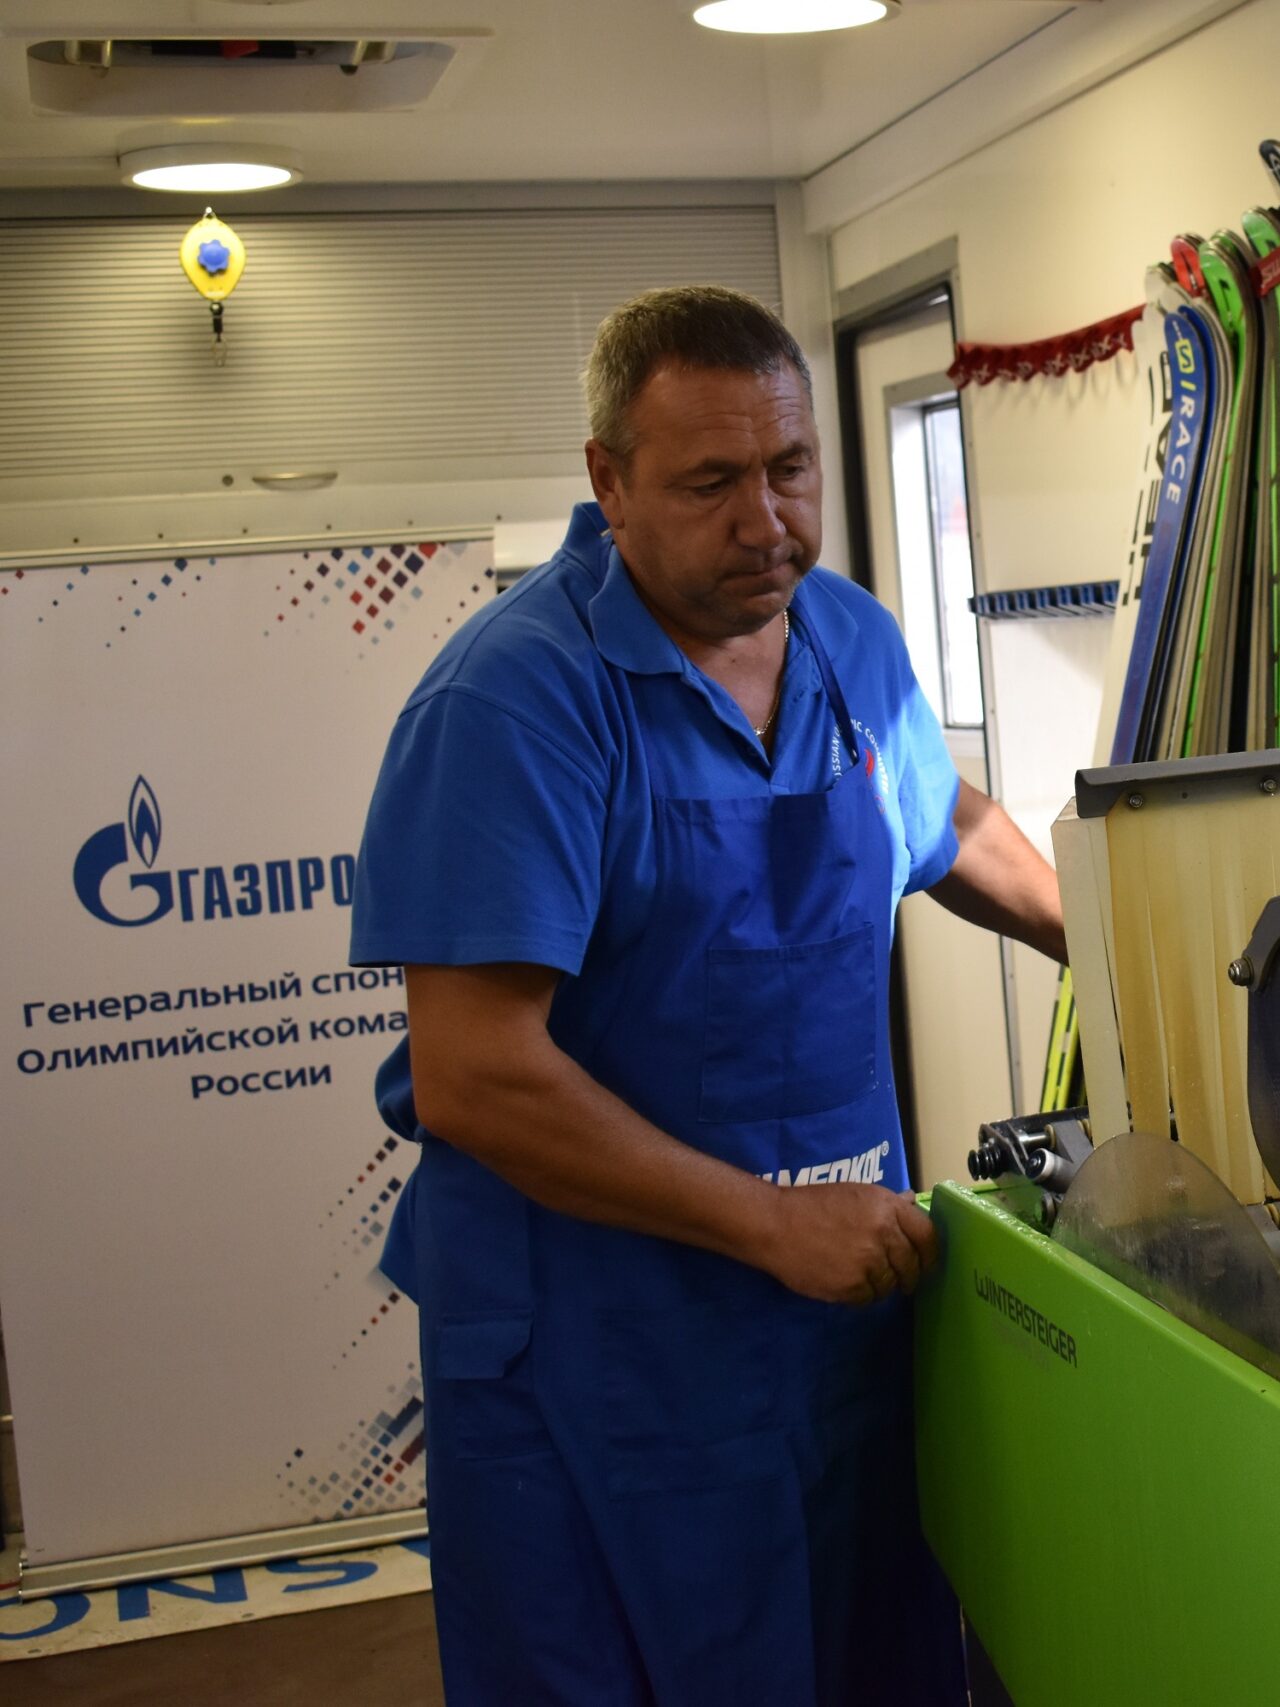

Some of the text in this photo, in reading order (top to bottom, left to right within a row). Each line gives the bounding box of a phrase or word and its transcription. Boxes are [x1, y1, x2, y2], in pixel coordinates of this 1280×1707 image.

[23, 972, 302, 1028] Генеральный
[17, 1018, 300, 1075] Олимпийской
[192, 1065, 333, 1099] России
[973, 1268, 1078, 1369] WINTERSTEIGER
